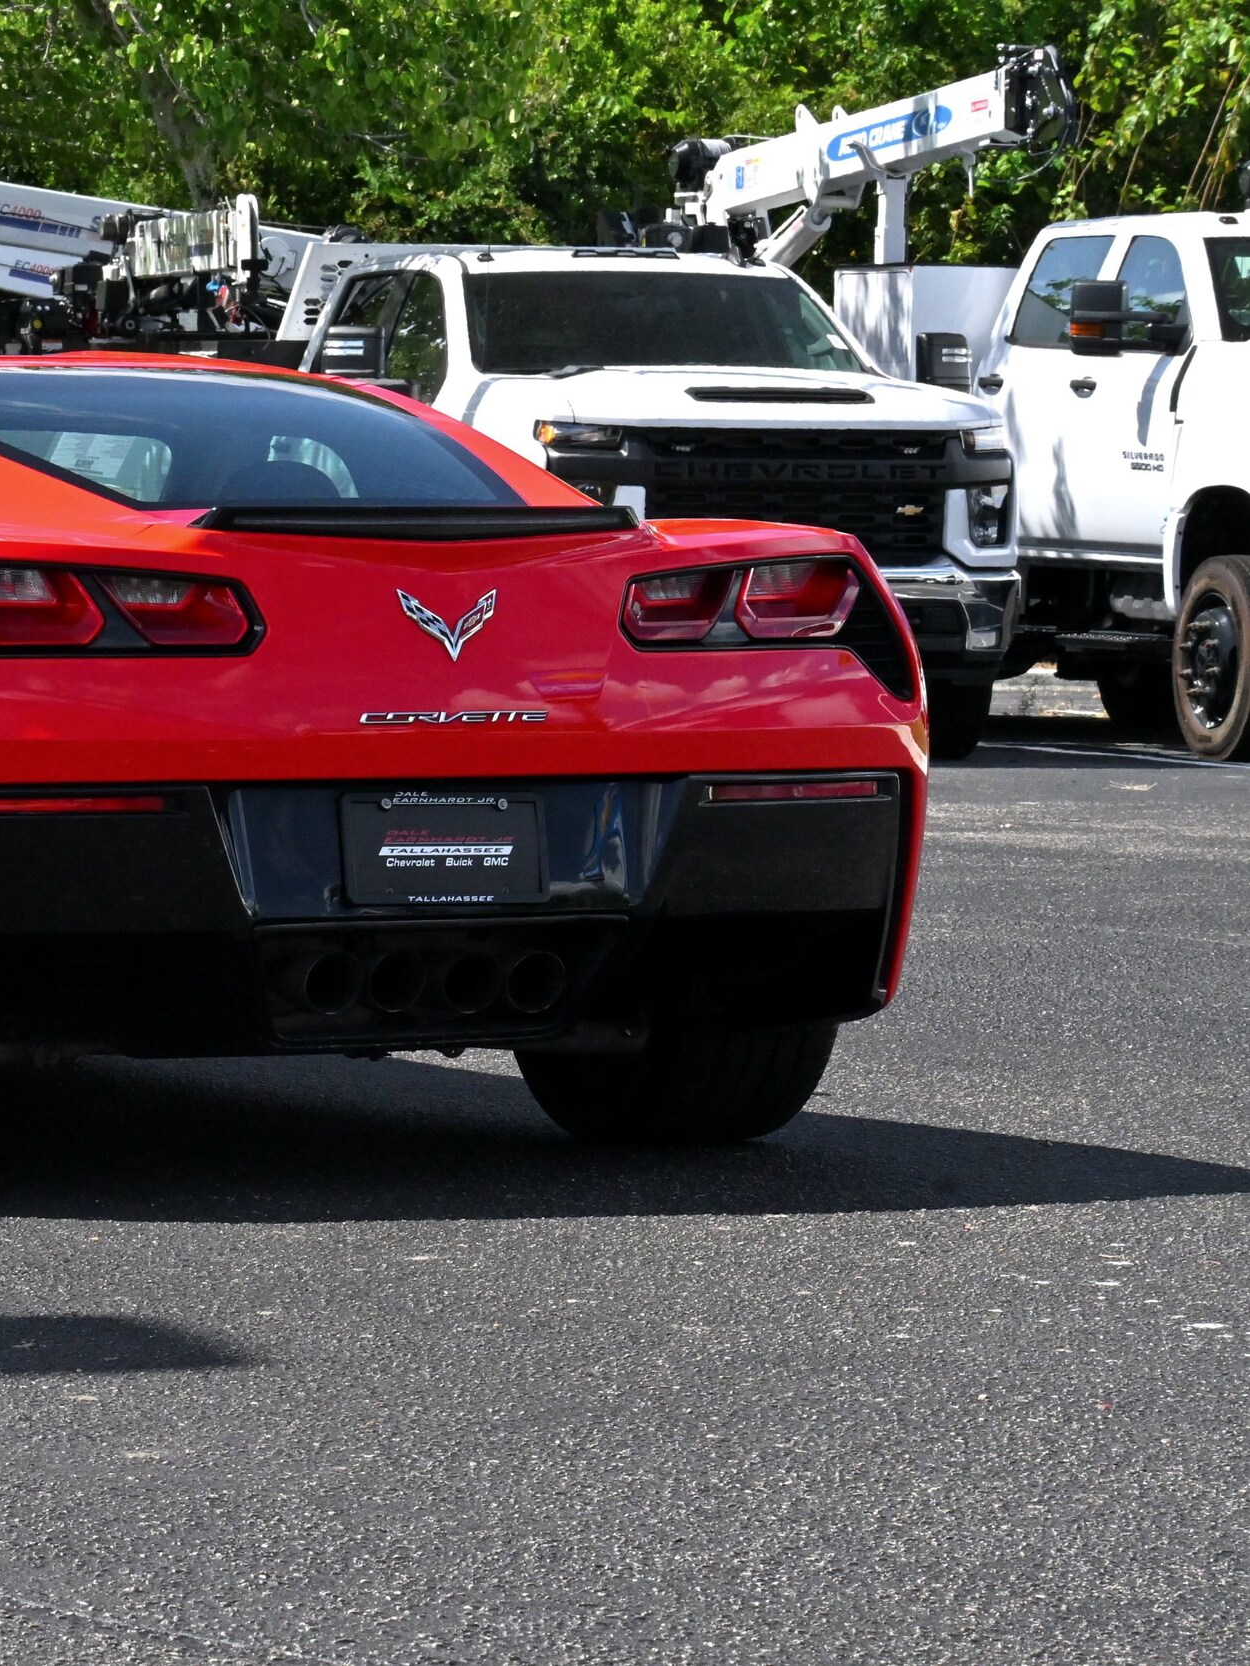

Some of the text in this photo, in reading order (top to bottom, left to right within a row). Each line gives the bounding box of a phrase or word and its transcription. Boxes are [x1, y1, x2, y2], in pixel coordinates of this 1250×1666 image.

[869, 120, 907, 148] CRANE
[1122, 451, 1165, 461] SILVERADO
[654, 461, 947, 480] CHEVROLET
[360, 711, 548, 724] CORVETTE
[392, 797, 473, 805] EARNHARDT
[384, 836, 487, 844] EARNHARDT
[386, 857, 509, 867] Chevrolet Buick GMC
